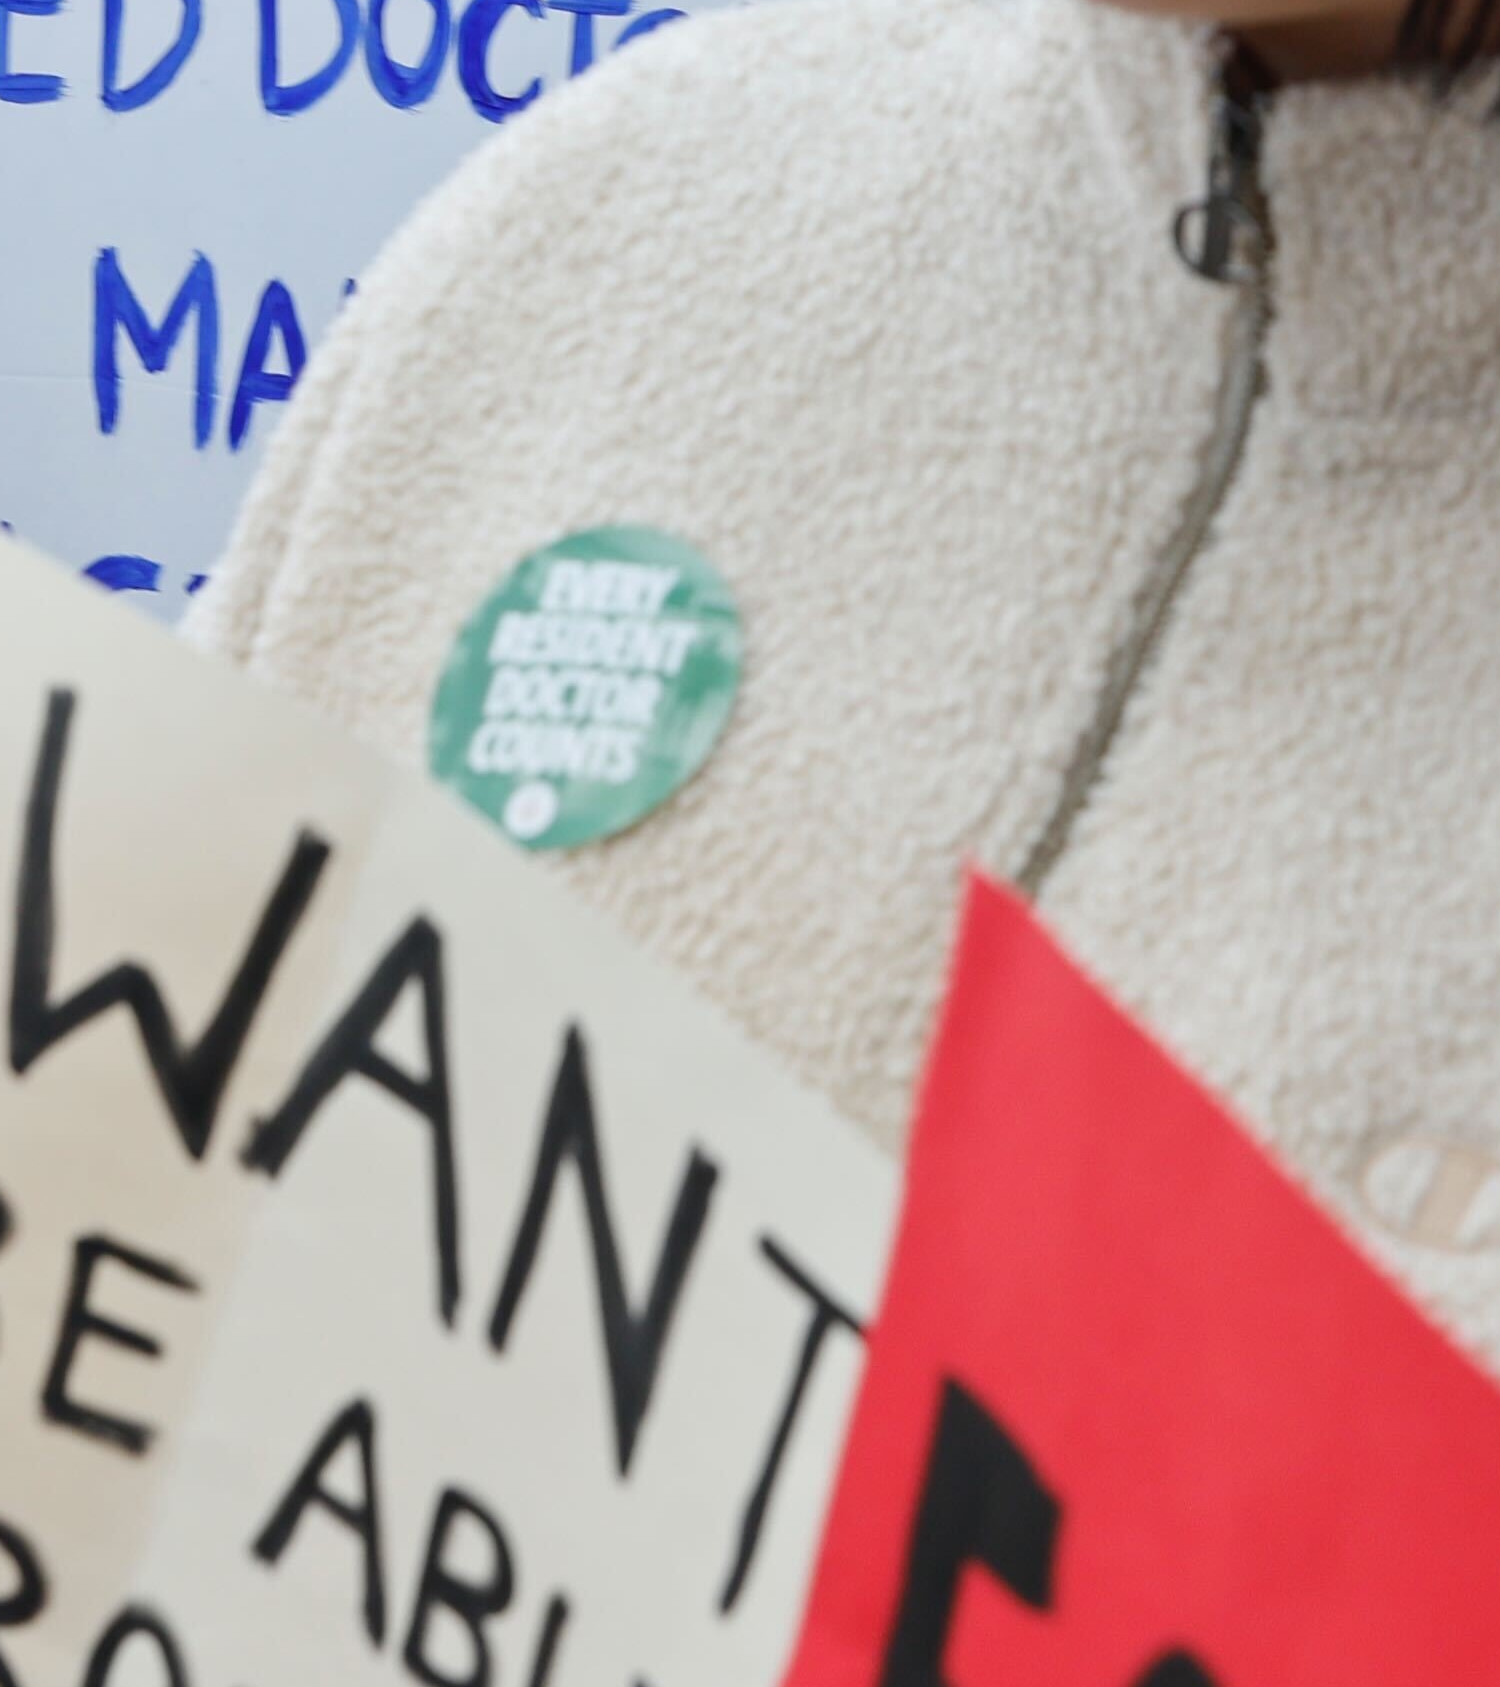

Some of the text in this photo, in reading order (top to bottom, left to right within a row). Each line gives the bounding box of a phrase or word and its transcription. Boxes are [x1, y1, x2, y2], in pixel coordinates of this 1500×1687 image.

[91, 246, 357, 454] MA
[540, 559, 682, 619] EVERY
[489, 611, 698, 679] RESIDENT
[482, 665, 664, 729] DOCTOR
[466, 719, 648, 785] COUNTS
[6, 688, 870, 1618] WANT
